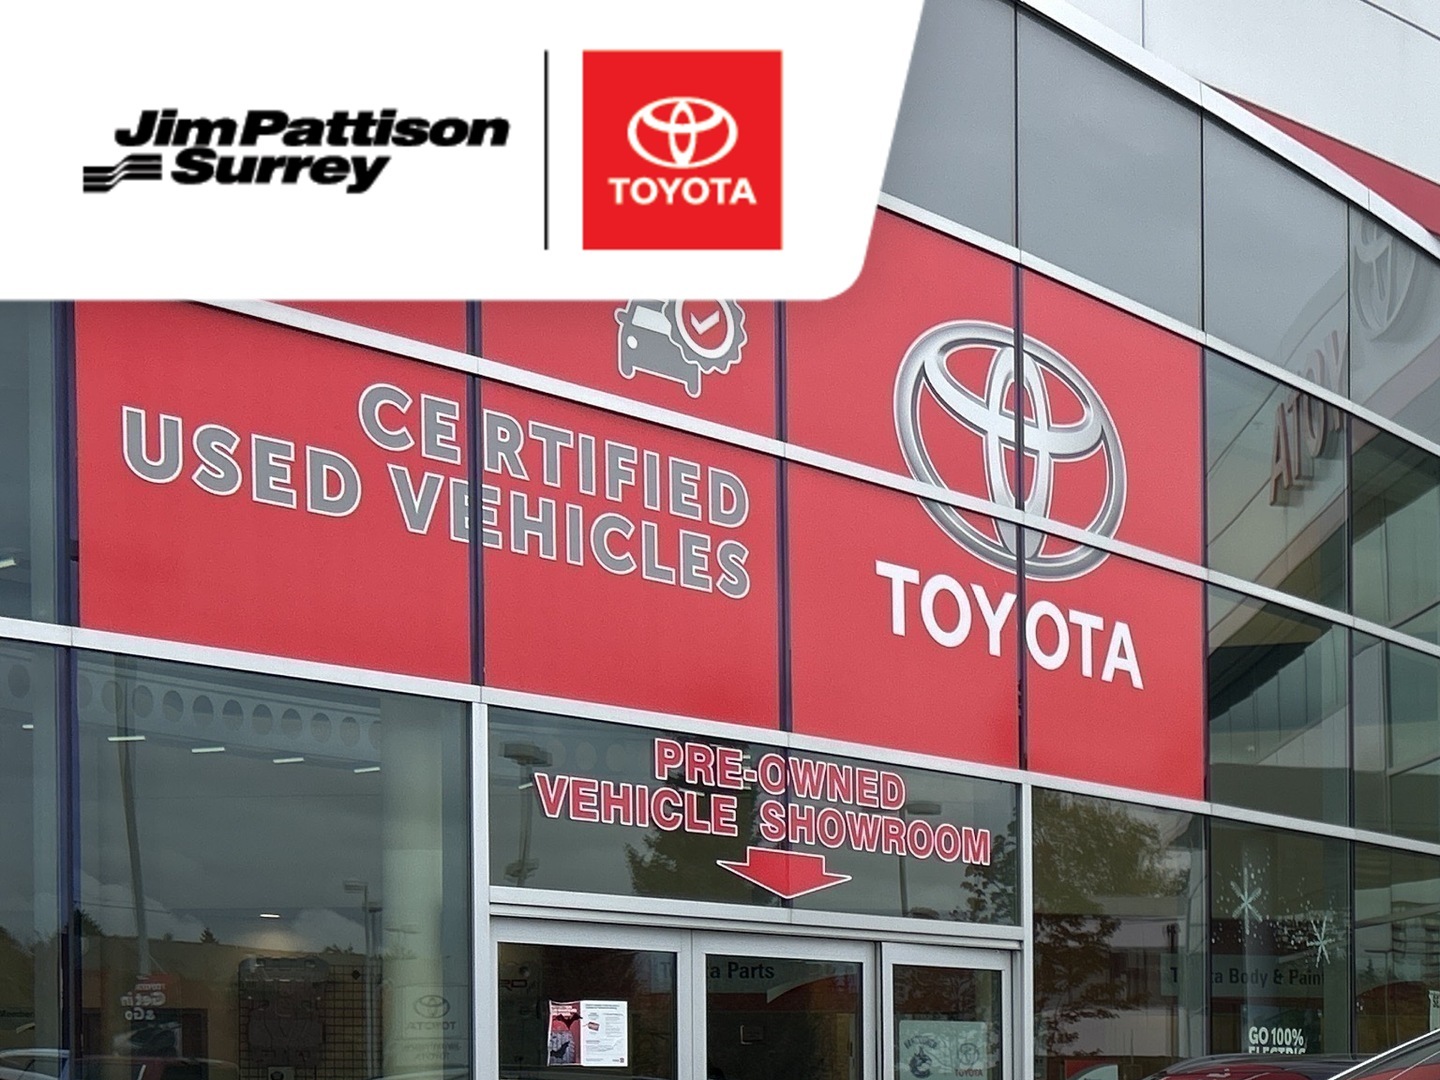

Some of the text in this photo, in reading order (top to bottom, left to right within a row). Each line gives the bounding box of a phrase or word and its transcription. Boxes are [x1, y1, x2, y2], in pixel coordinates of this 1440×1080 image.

[358, 382, 750, 529] CERTIFIED
[121, 404, 752, 600] USED VEHICLES
[875, 559, 1145, 691] TOYOTA
[653, 737, 906, 811] PRE-OWNED
[533, 771, 992, 867] VEHICLE SHOWROOM
[727, 961, 775, 979] Parts
[1229, 968, 1269, 988] Body
[1248, 1026, 1304, 1046] GO 100%
